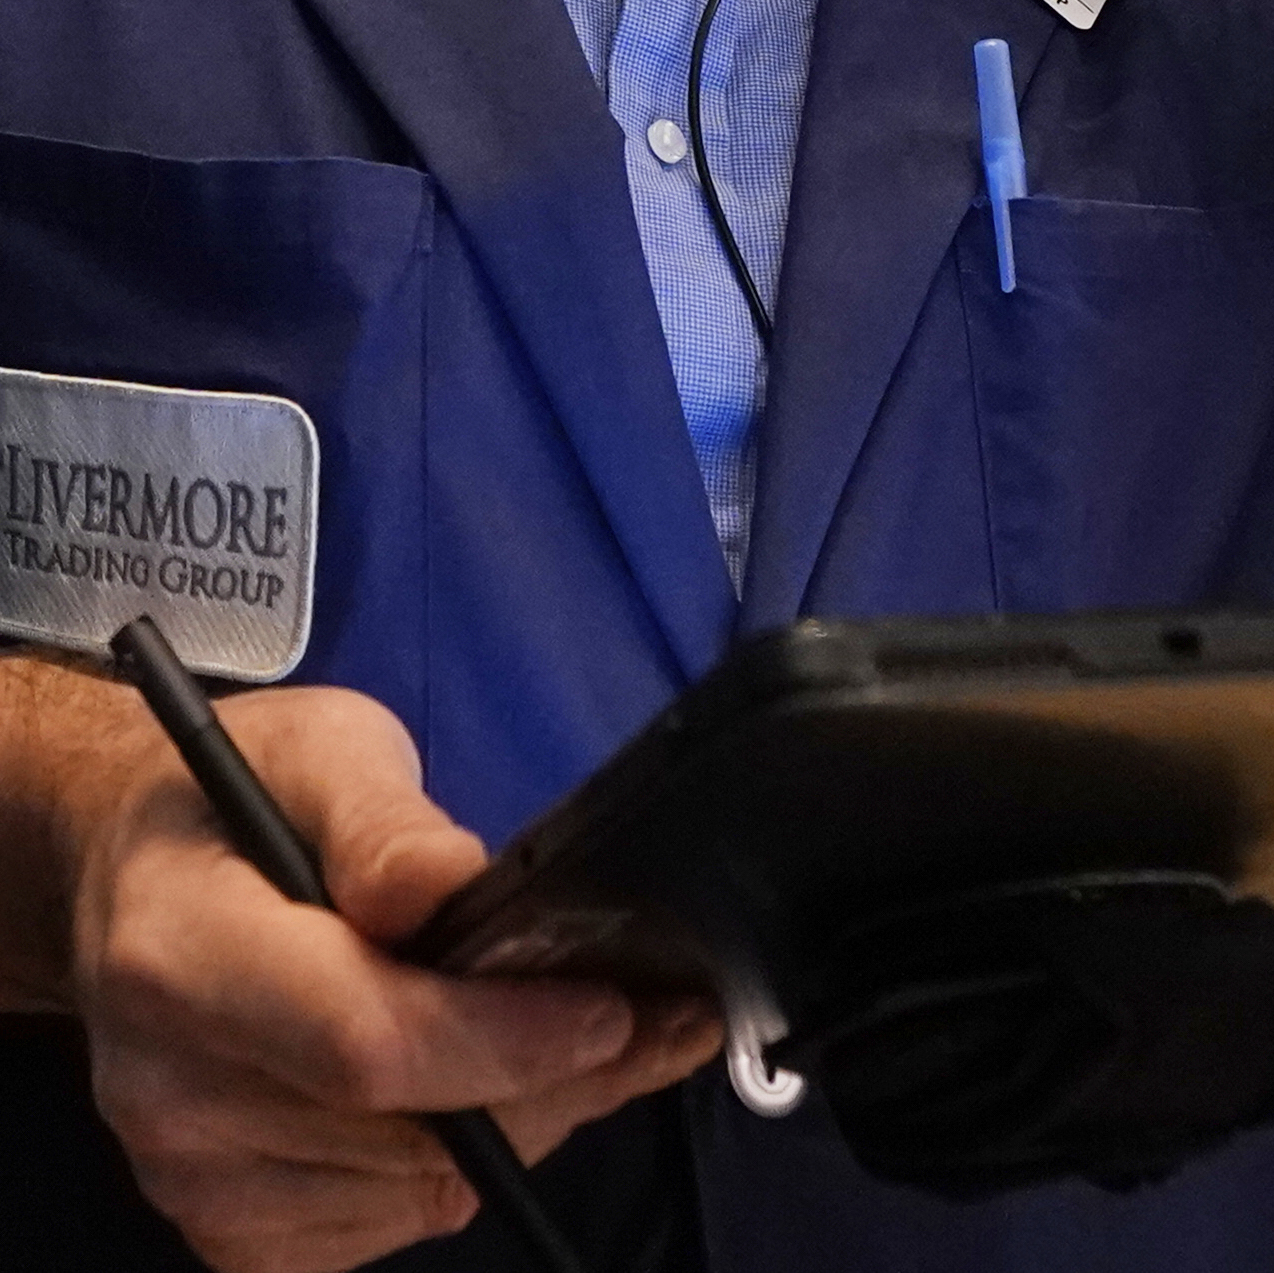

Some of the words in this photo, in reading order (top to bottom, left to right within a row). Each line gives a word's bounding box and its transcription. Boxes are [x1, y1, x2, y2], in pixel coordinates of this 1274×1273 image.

[6, 444, 288, 559] LIVERMORE
[4, 529, 150, 589] TRADING
[159, 555, 285, 609] GROUP
